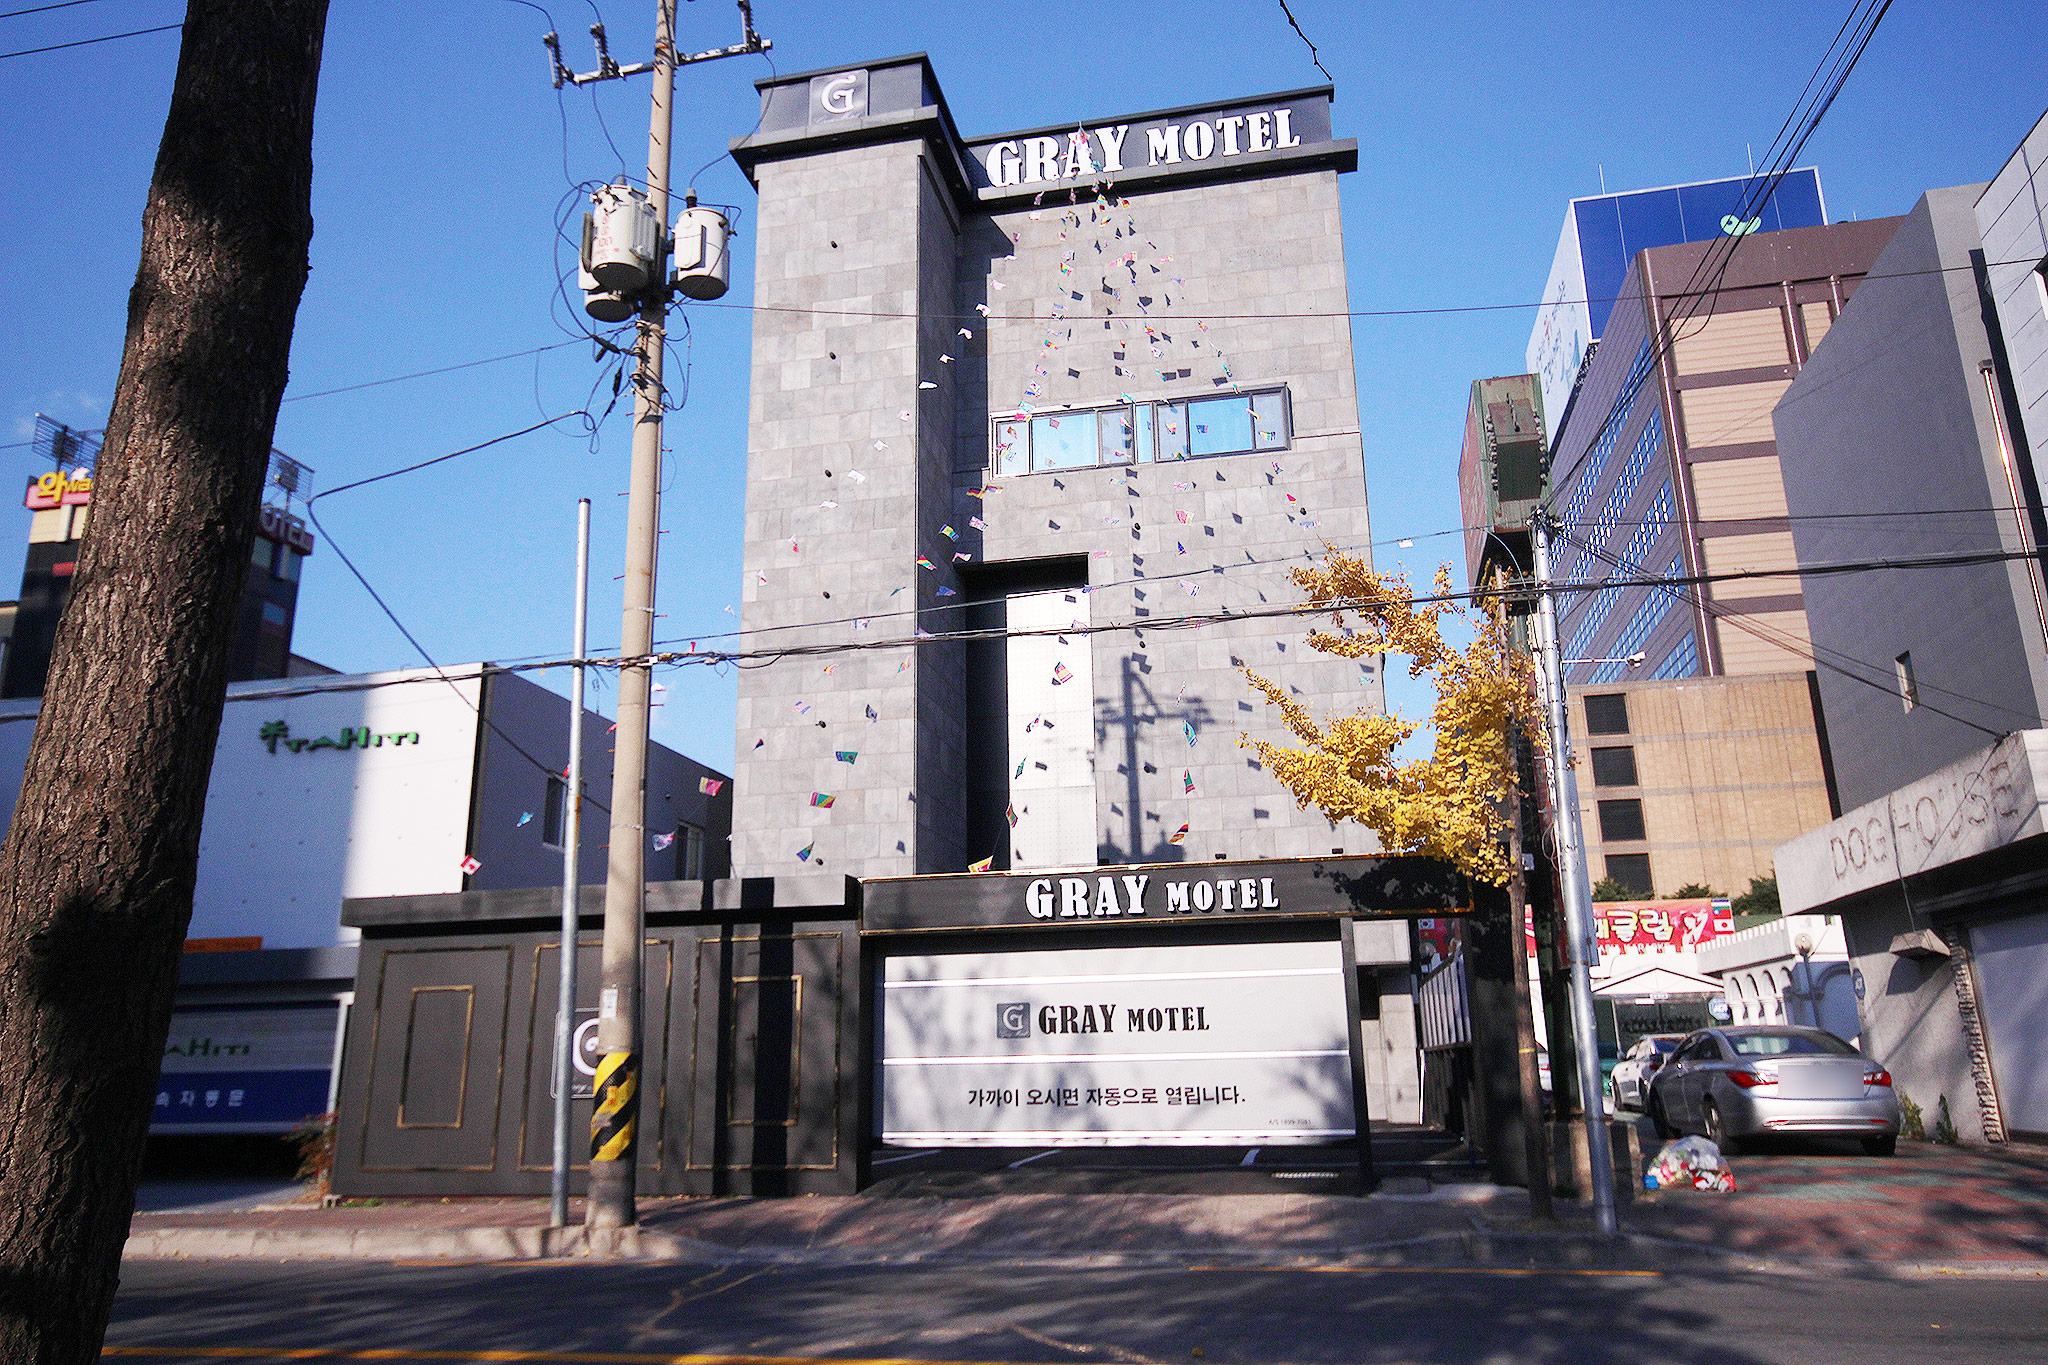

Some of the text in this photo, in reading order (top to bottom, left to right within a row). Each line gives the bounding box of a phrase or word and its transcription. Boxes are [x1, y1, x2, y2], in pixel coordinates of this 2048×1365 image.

[820, 75, 858, 114] G
[985, 109, 1301, 188] GRAY MOTEL
[1026, 875, 1280, 919] GRAY MOTEL
[1038, 1004, 1211, 1035] GRAY MOTEL
[968, 1085, 1246, 1108] 가까이 오시면 자동으로 열립니다.
